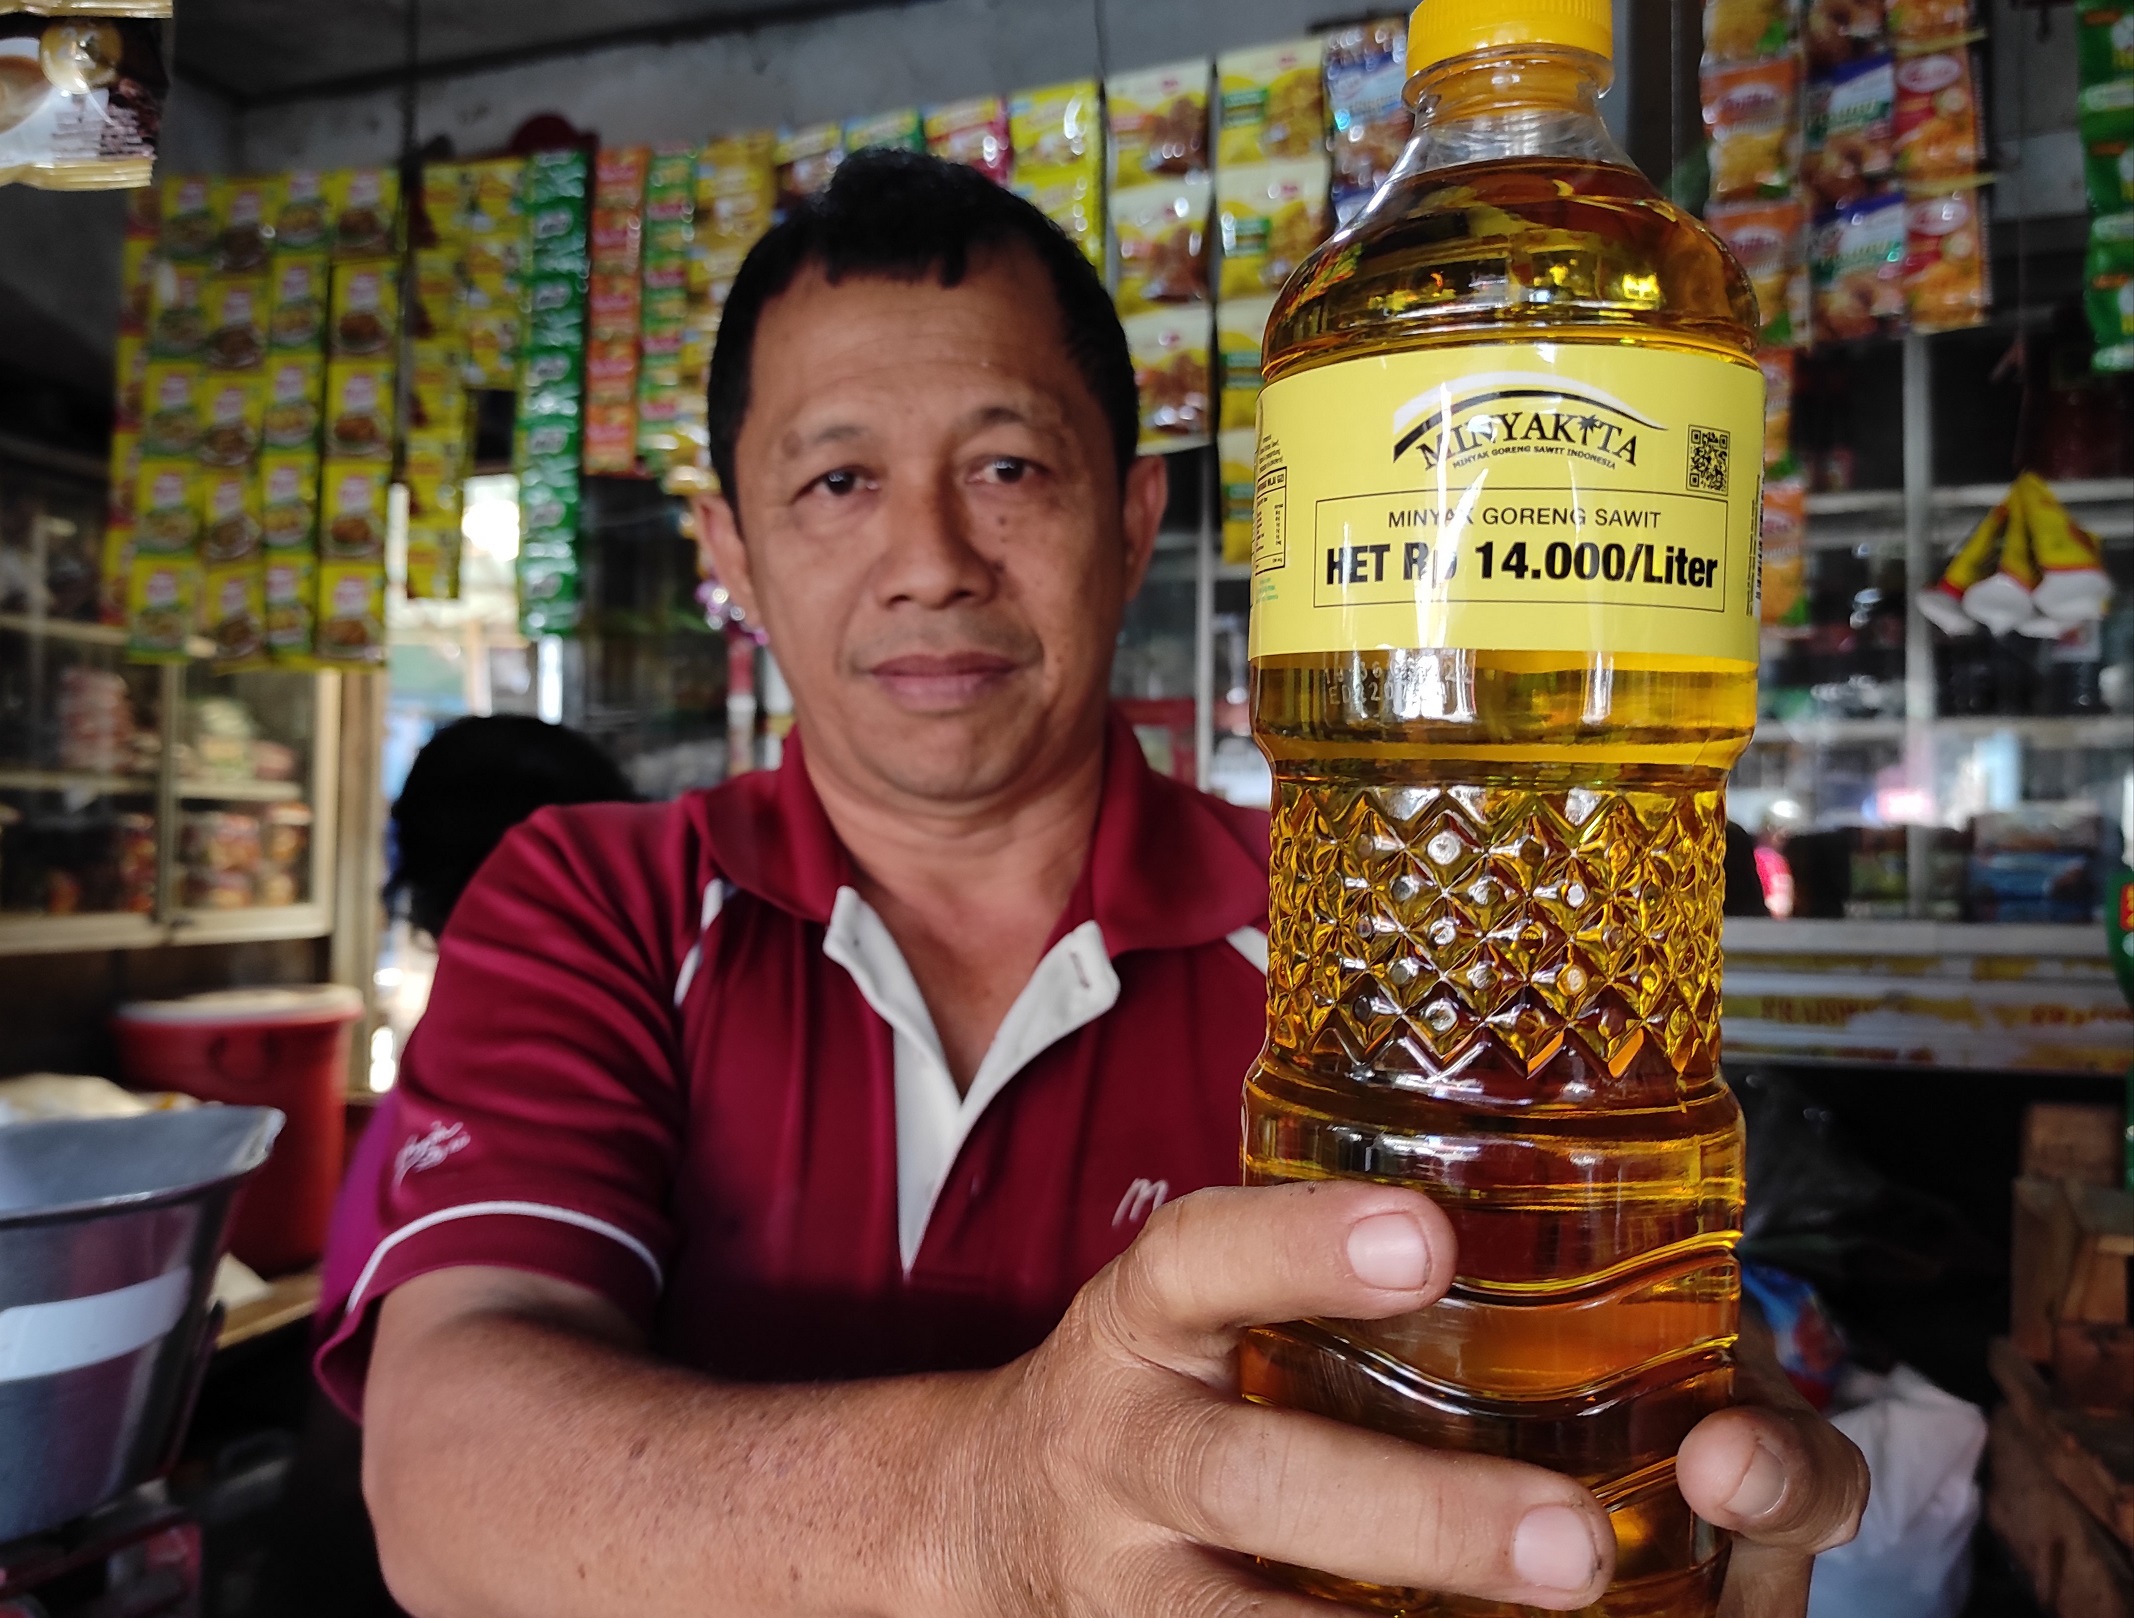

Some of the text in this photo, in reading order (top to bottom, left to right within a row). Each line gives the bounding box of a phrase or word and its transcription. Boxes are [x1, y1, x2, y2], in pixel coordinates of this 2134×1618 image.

[1415, 411, 1637, 471] MINYAKITA
[1452, 445, 1617, 470] MINYAK GORENG SAWIT INDONESIA
[1482, 506, 1586, 526] GORENG
[1594, 508, 1662, 529] SAWIT
[1326, 543, 1391, 585] HET
[1474, 540, 1718, 589] 14.000/Liter
